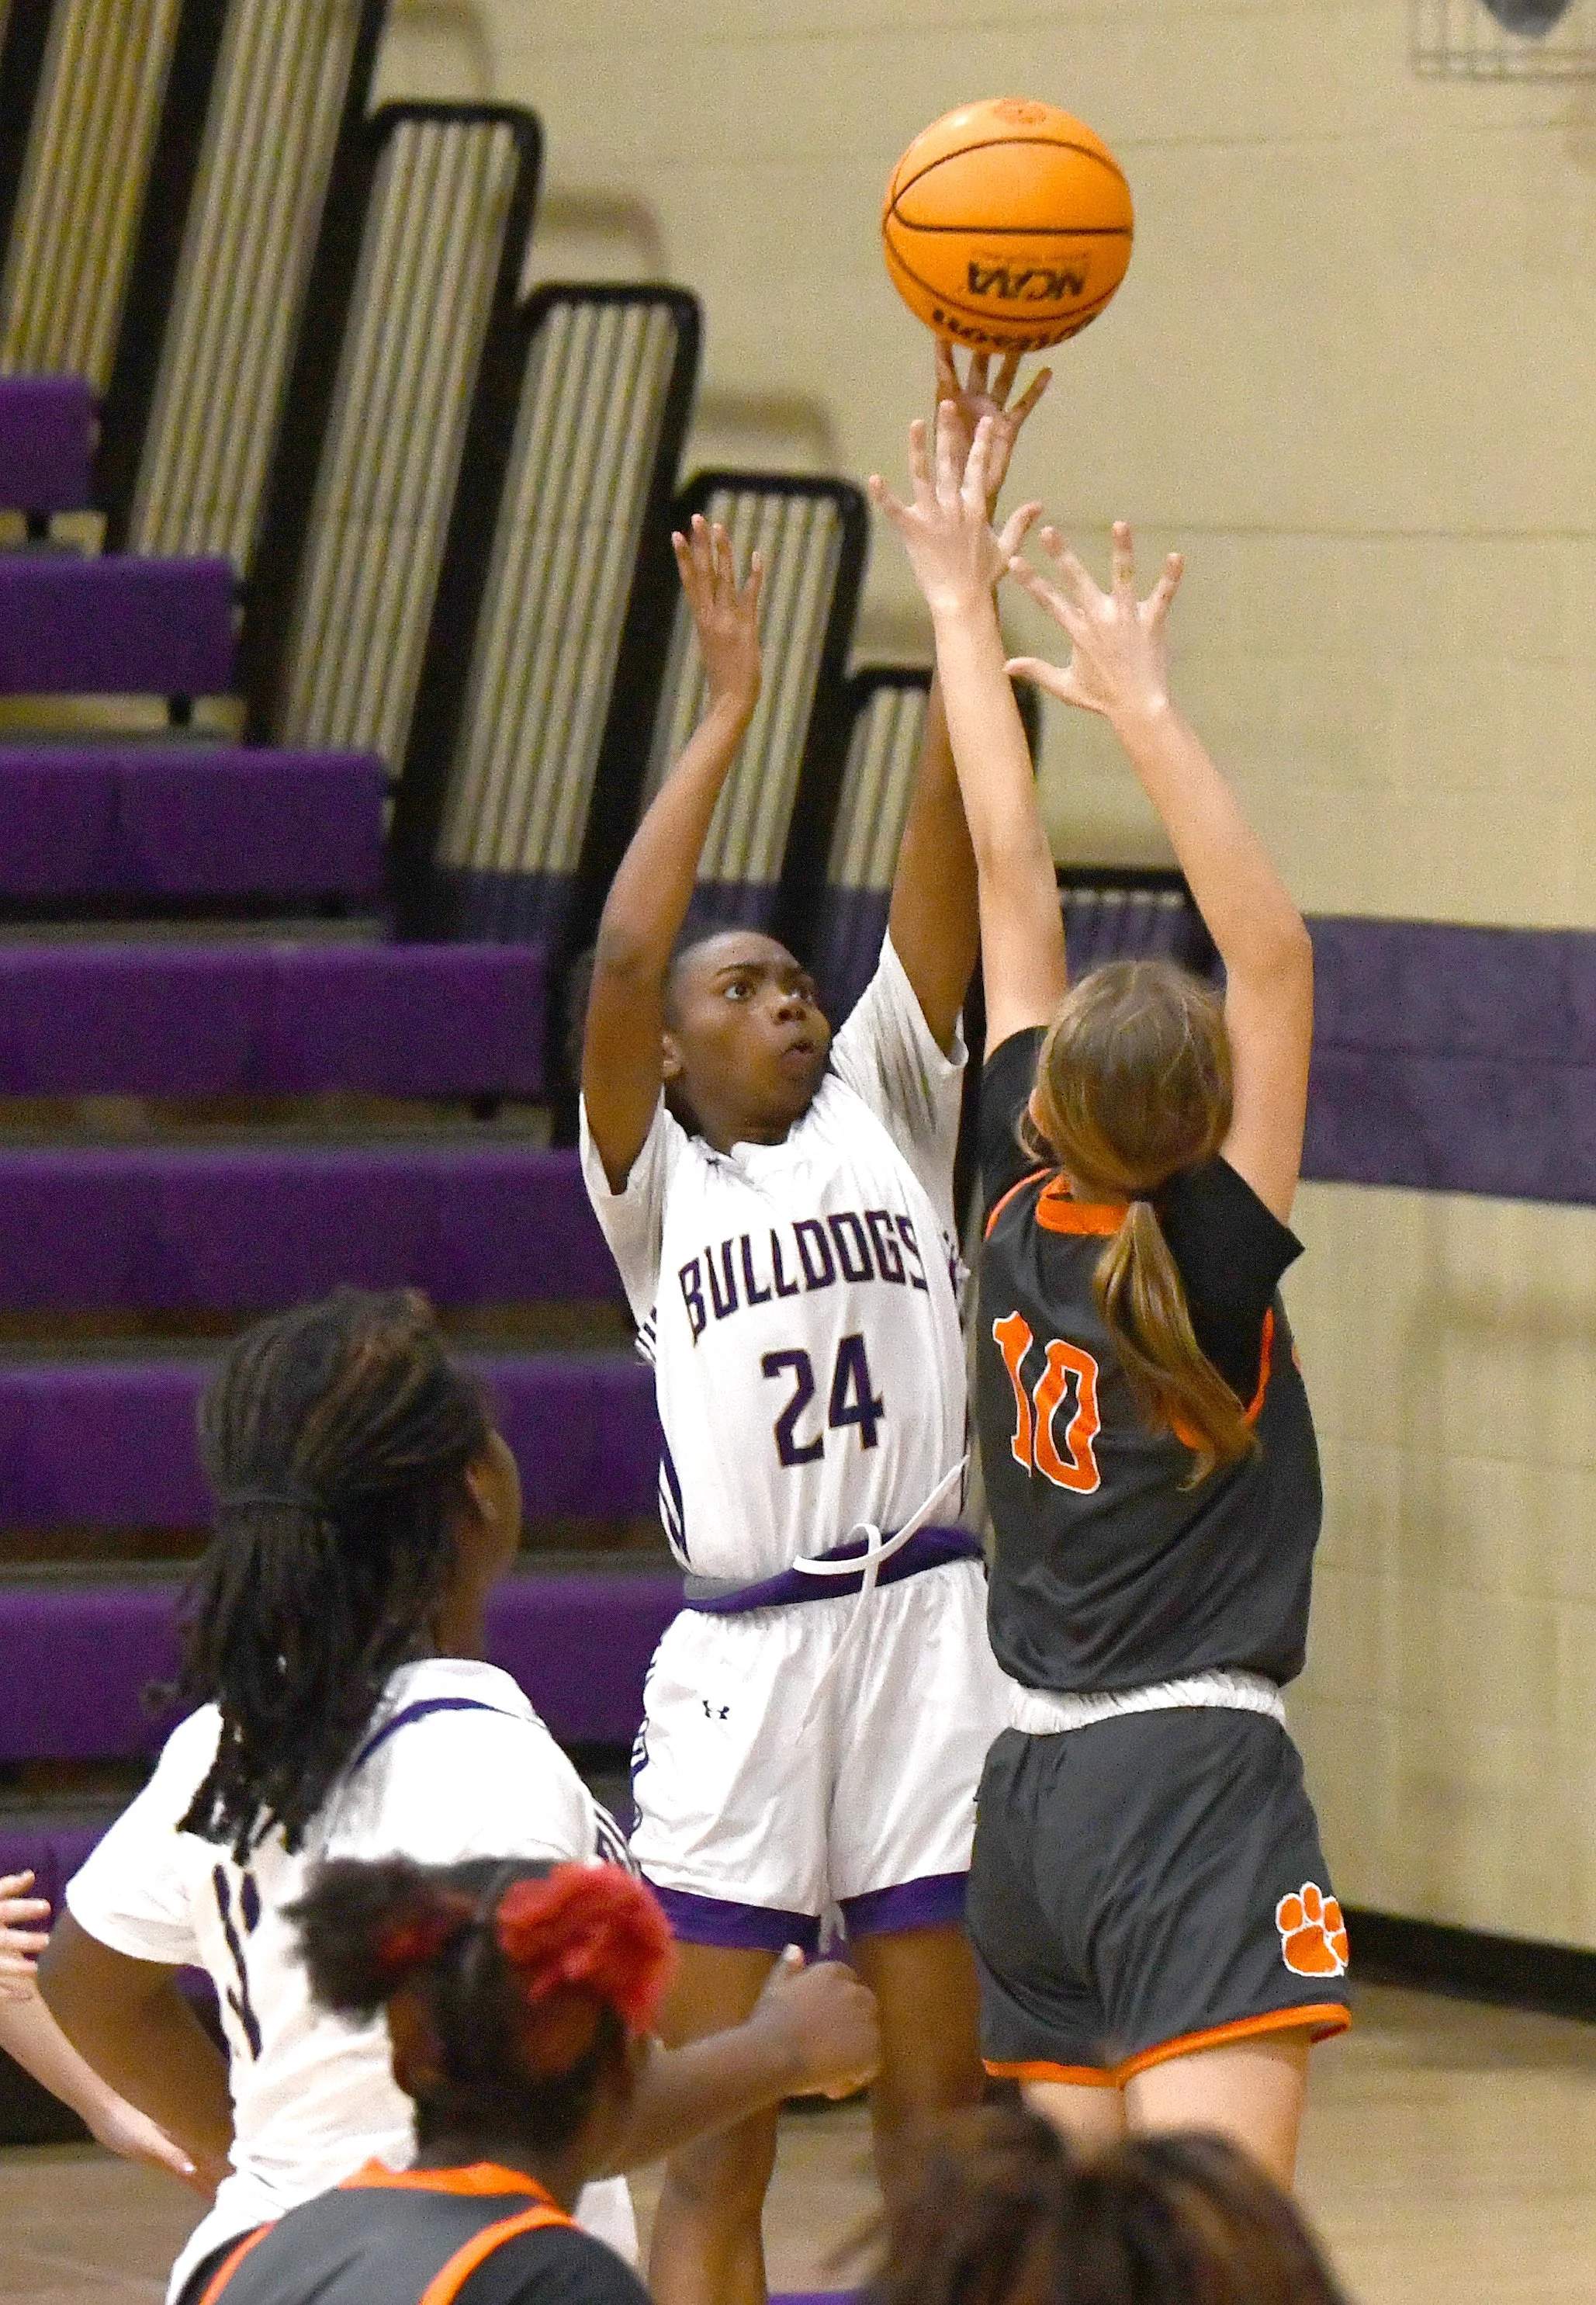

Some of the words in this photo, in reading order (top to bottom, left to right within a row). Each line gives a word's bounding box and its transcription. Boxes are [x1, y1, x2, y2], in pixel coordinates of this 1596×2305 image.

[968, 259, 1085, 301] NCAA
[678, 1209, 930, 1347] BULLDOGS
[761, 1333, 885, 1467] 24
[992, 1311, 1101, 1495] 10
